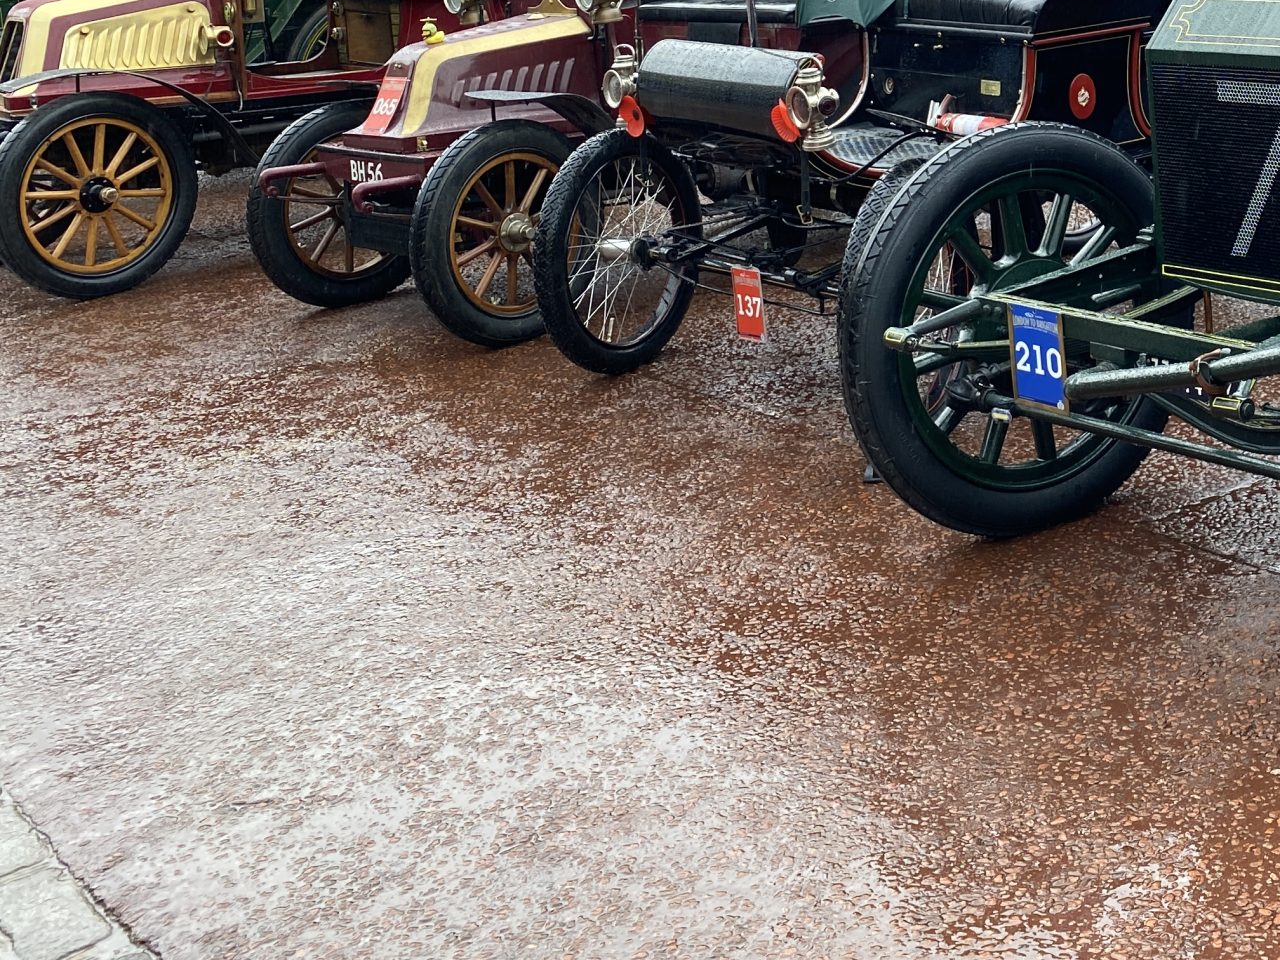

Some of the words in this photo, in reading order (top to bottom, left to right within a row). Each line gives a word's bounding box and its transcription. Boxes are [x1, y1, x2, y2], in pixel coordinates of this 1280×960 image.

[372, 98, 399, 116] 065
[350, 159, 366, 182] BH
[367, 162, 383, 182] 56
[737, 294, 761, 318] 137
[1015, 341, 1063, 379] 210
